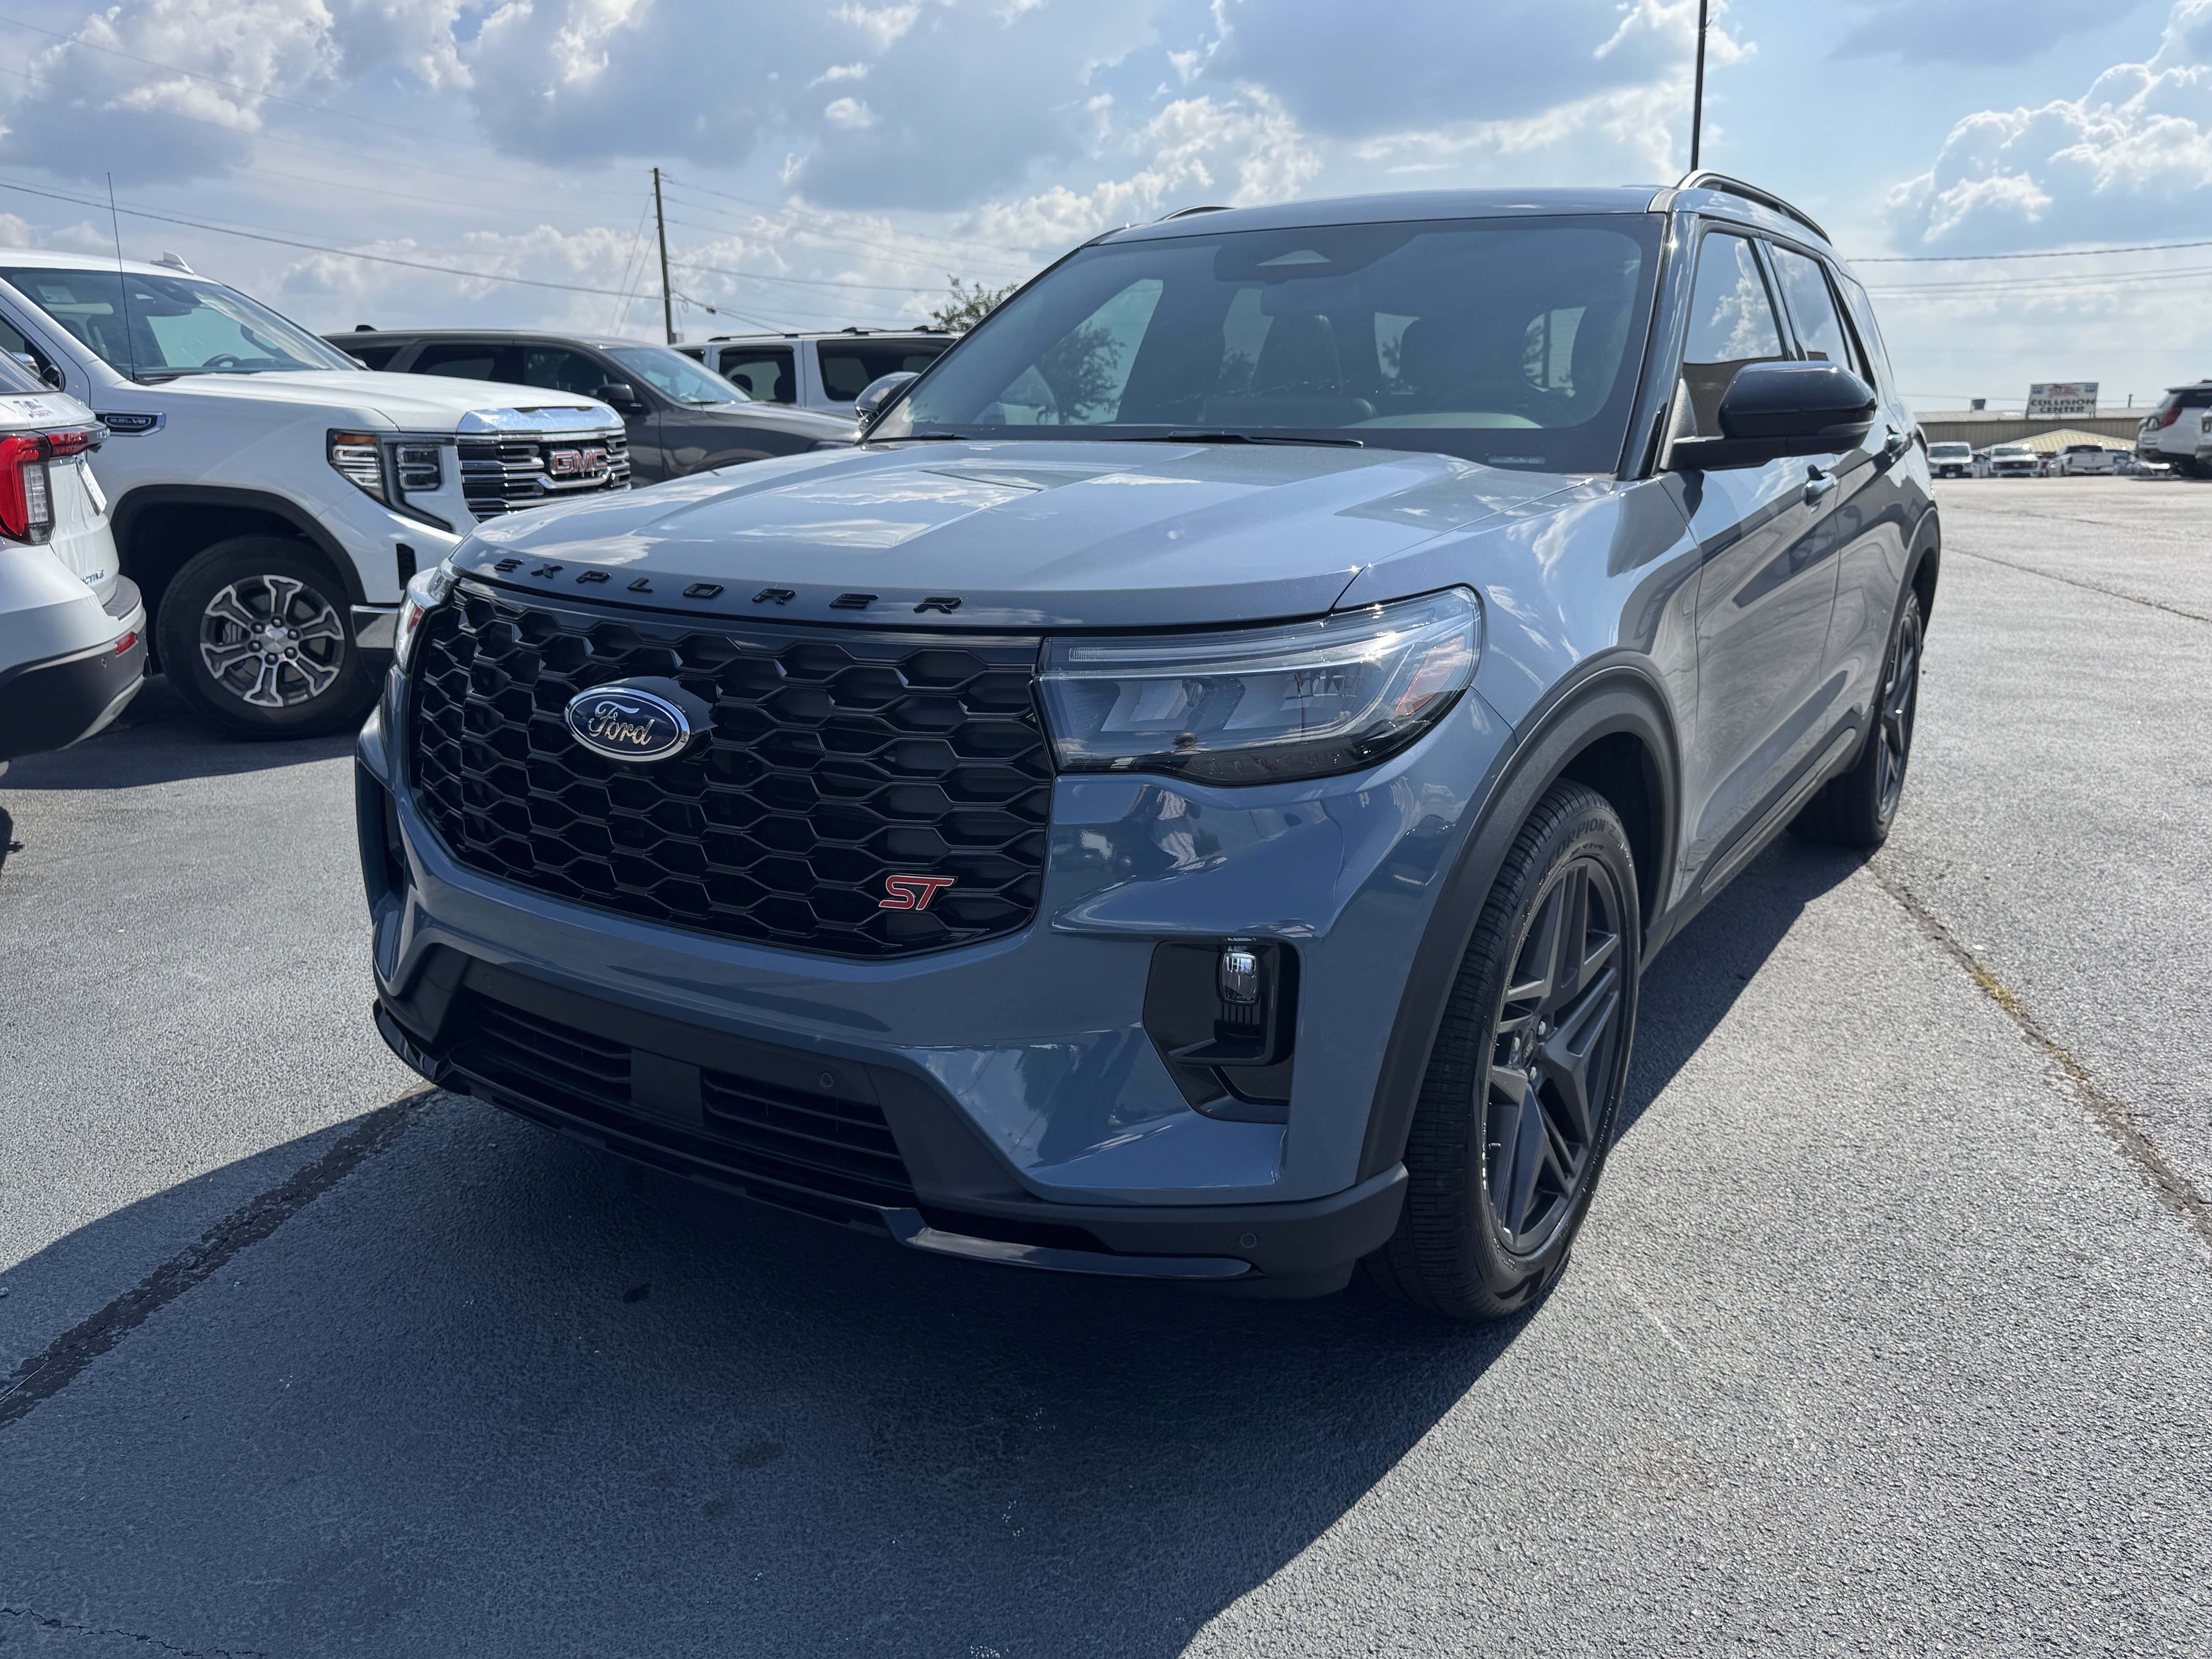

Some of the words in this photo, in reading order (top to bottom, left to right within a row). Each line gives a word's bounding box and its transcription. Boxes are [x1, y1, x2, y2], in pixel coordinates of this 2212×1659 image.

[2031, 398, 2095, 406] COLLISION
[551, 448, 608, 474] GMC
[493, 558, 963, 615] EXPLORER
[587, 701, 655, 745] Ford
[878, 875, 955, 910] ST
